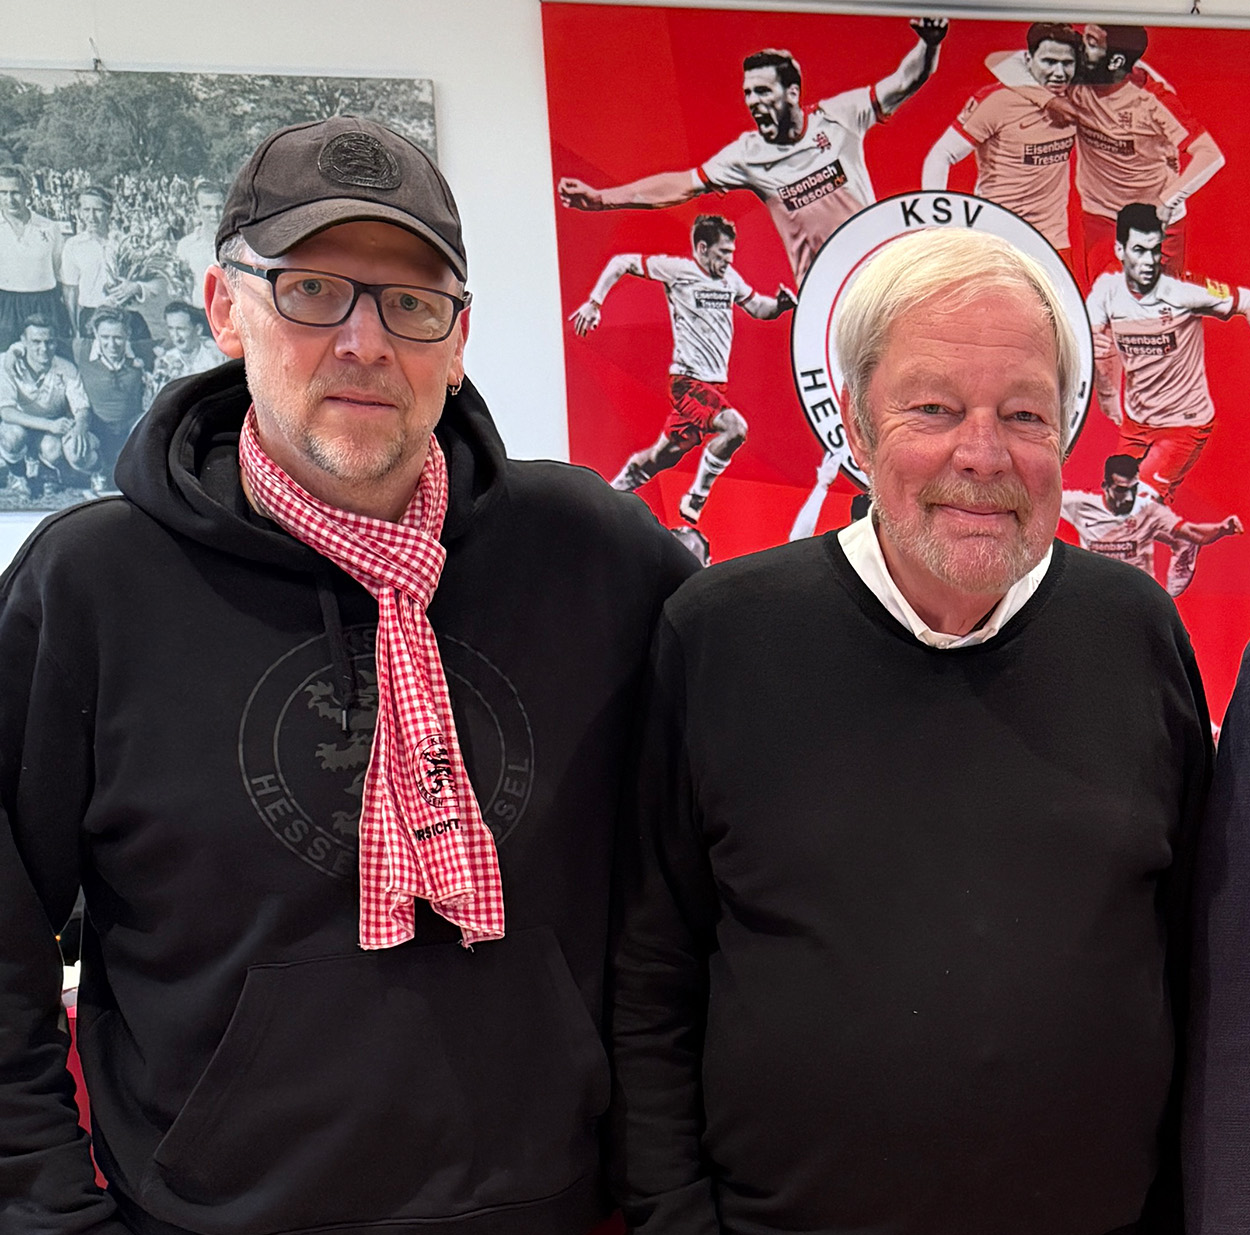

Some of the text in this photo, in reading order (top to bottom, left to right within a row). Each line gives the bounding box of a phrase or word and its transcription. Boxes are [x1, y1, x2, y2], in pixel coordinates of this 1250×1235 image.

[779, 164, 838, 200] Eisenbach
[790, 183, 834, 210] Tresore
[900, 197, 983, 228] KSV
